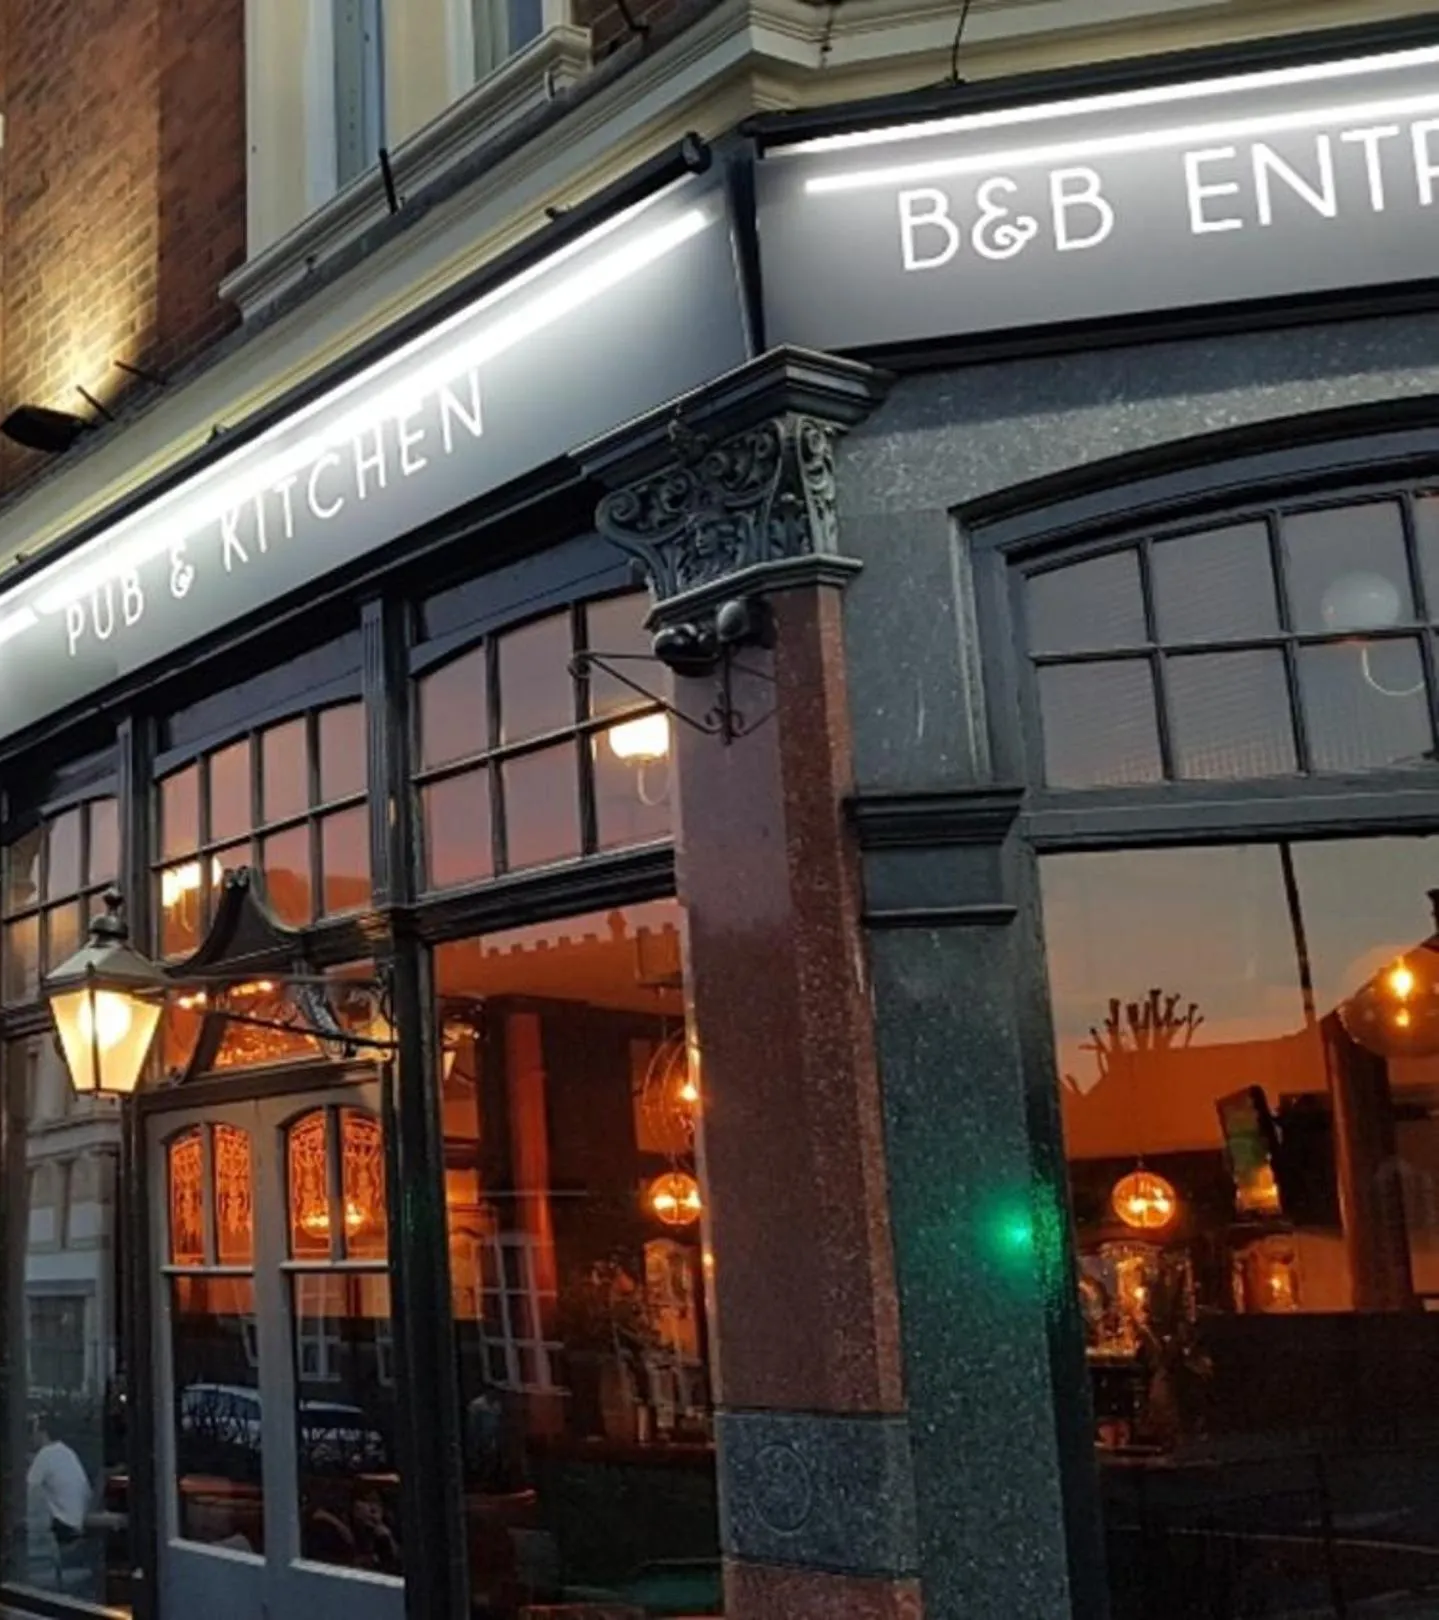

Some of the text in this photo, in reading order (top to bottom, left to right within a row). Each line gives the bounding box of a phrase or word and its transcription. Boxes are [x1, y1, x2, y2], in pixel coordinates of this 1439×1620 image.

[897, 166, 1115, 271] B&B
[66, 366, 483, 655] PUB & KITCHEN
